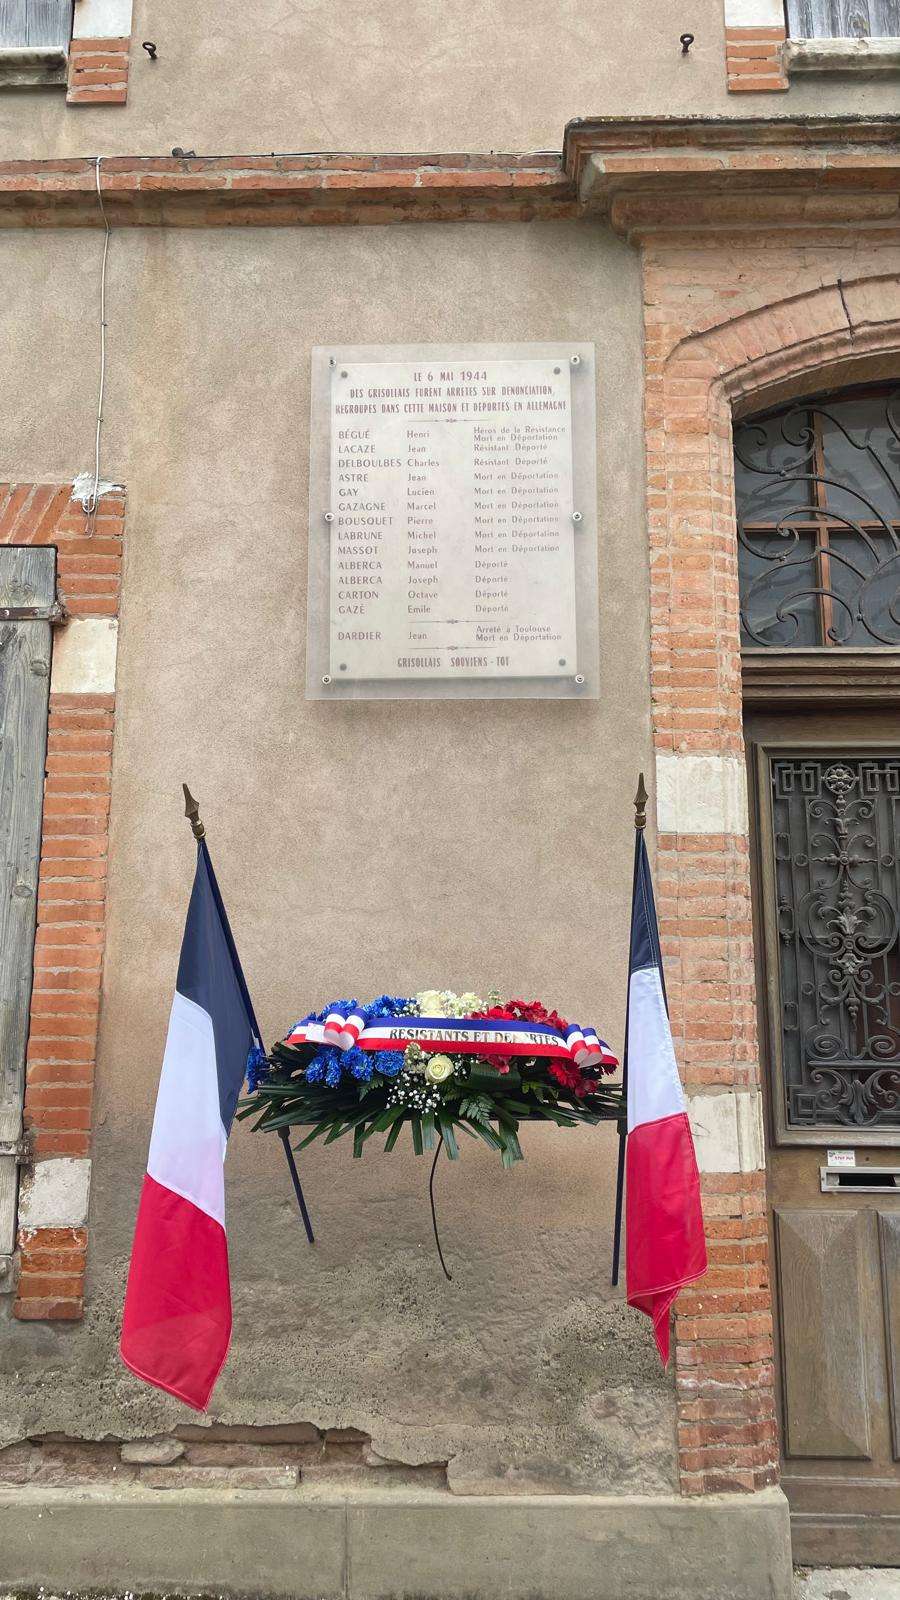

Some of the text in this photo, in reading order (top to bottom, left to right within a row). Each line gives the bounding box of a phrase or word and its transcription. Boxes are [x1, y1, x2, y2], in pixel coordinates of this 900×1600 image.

[414, 371, 487, 382] LE 6 MAI 1944
[350, 388, 364, 398] DES
[368, 388, 410, 398] GRISOLLAIS
[415, 387, 442, 397] FURENT
[482, 386, 496, 396] SUR
[382, 403, 400, 413] DANS
[404, 403, 424, 413] CETTE
[429, 402, 457, 413] MAISON
[461, 402, 469, 412] ET
[514, 401, 523, 411] EN
[527, 400, 566, 410] ALLEMAGNE
[406, 430, 430, 438] Henri
[501, 426, 510, 434] de
[473, 434, 493, 442] Mort
[510, 434, 558, 442] Déportation
[338, 444, 376, 454] LACAZE
[407, 444, 426, 453] Jean
[515, 443, 547, 452] Déporté
[407, 458, 440, 467] Charles
[515, 457, 548, 466] Déporté
[338, 473, 368, 482] ASTRE
[407, 473, 426, 482] Jean
[473, 472, 493, 480] Mort
[511, 472, 559, 480] Déportation
[338, 488, 359, 497] GAY
[407, 487, 435, 496] Lucien
[474, 486, 494, 495] Mort
[511, 485, 559, 495] Déportation
[338, 502, 386, 511] GAZAGNE
[407, 502, 437, 510] Marcel
[474, 501, 493, 509] Mort
[511, 501, 559, 510] Déportation
[407, 516, 433, 525] Pierre
[474, 516, 493, 524] Mort
[338, 531, 383, 540] LABRUNE
[407, 531, 437, 540] Michel
[474, 530, 494, 538] Mort
[338, 546, 378, 555] MASSOT
[408, 545, 438, 556] Joseph
[474, 545, 494, 553] Mort
[512, 544, 560, 553] Déportation
[338, 560, 508, 570] ALBERCA Manuel Déporté
[338, 576, 383, 585] ALBERCA
[408, 575, 438, 586] Joseph
[338, 590, 379, 600] CARTON
[408, 590, 438, 599] Octave
[515, 625, 551, 633] Toulouse
[338, 631, 427, 640] DARDIER Jean
[475, 634, 496, 642] Mort
[513, 633, 562, 642] Déportation
[397, 657, 441, 668] GRISOLLAIS
[473, 1031, 490, 1043] ET
